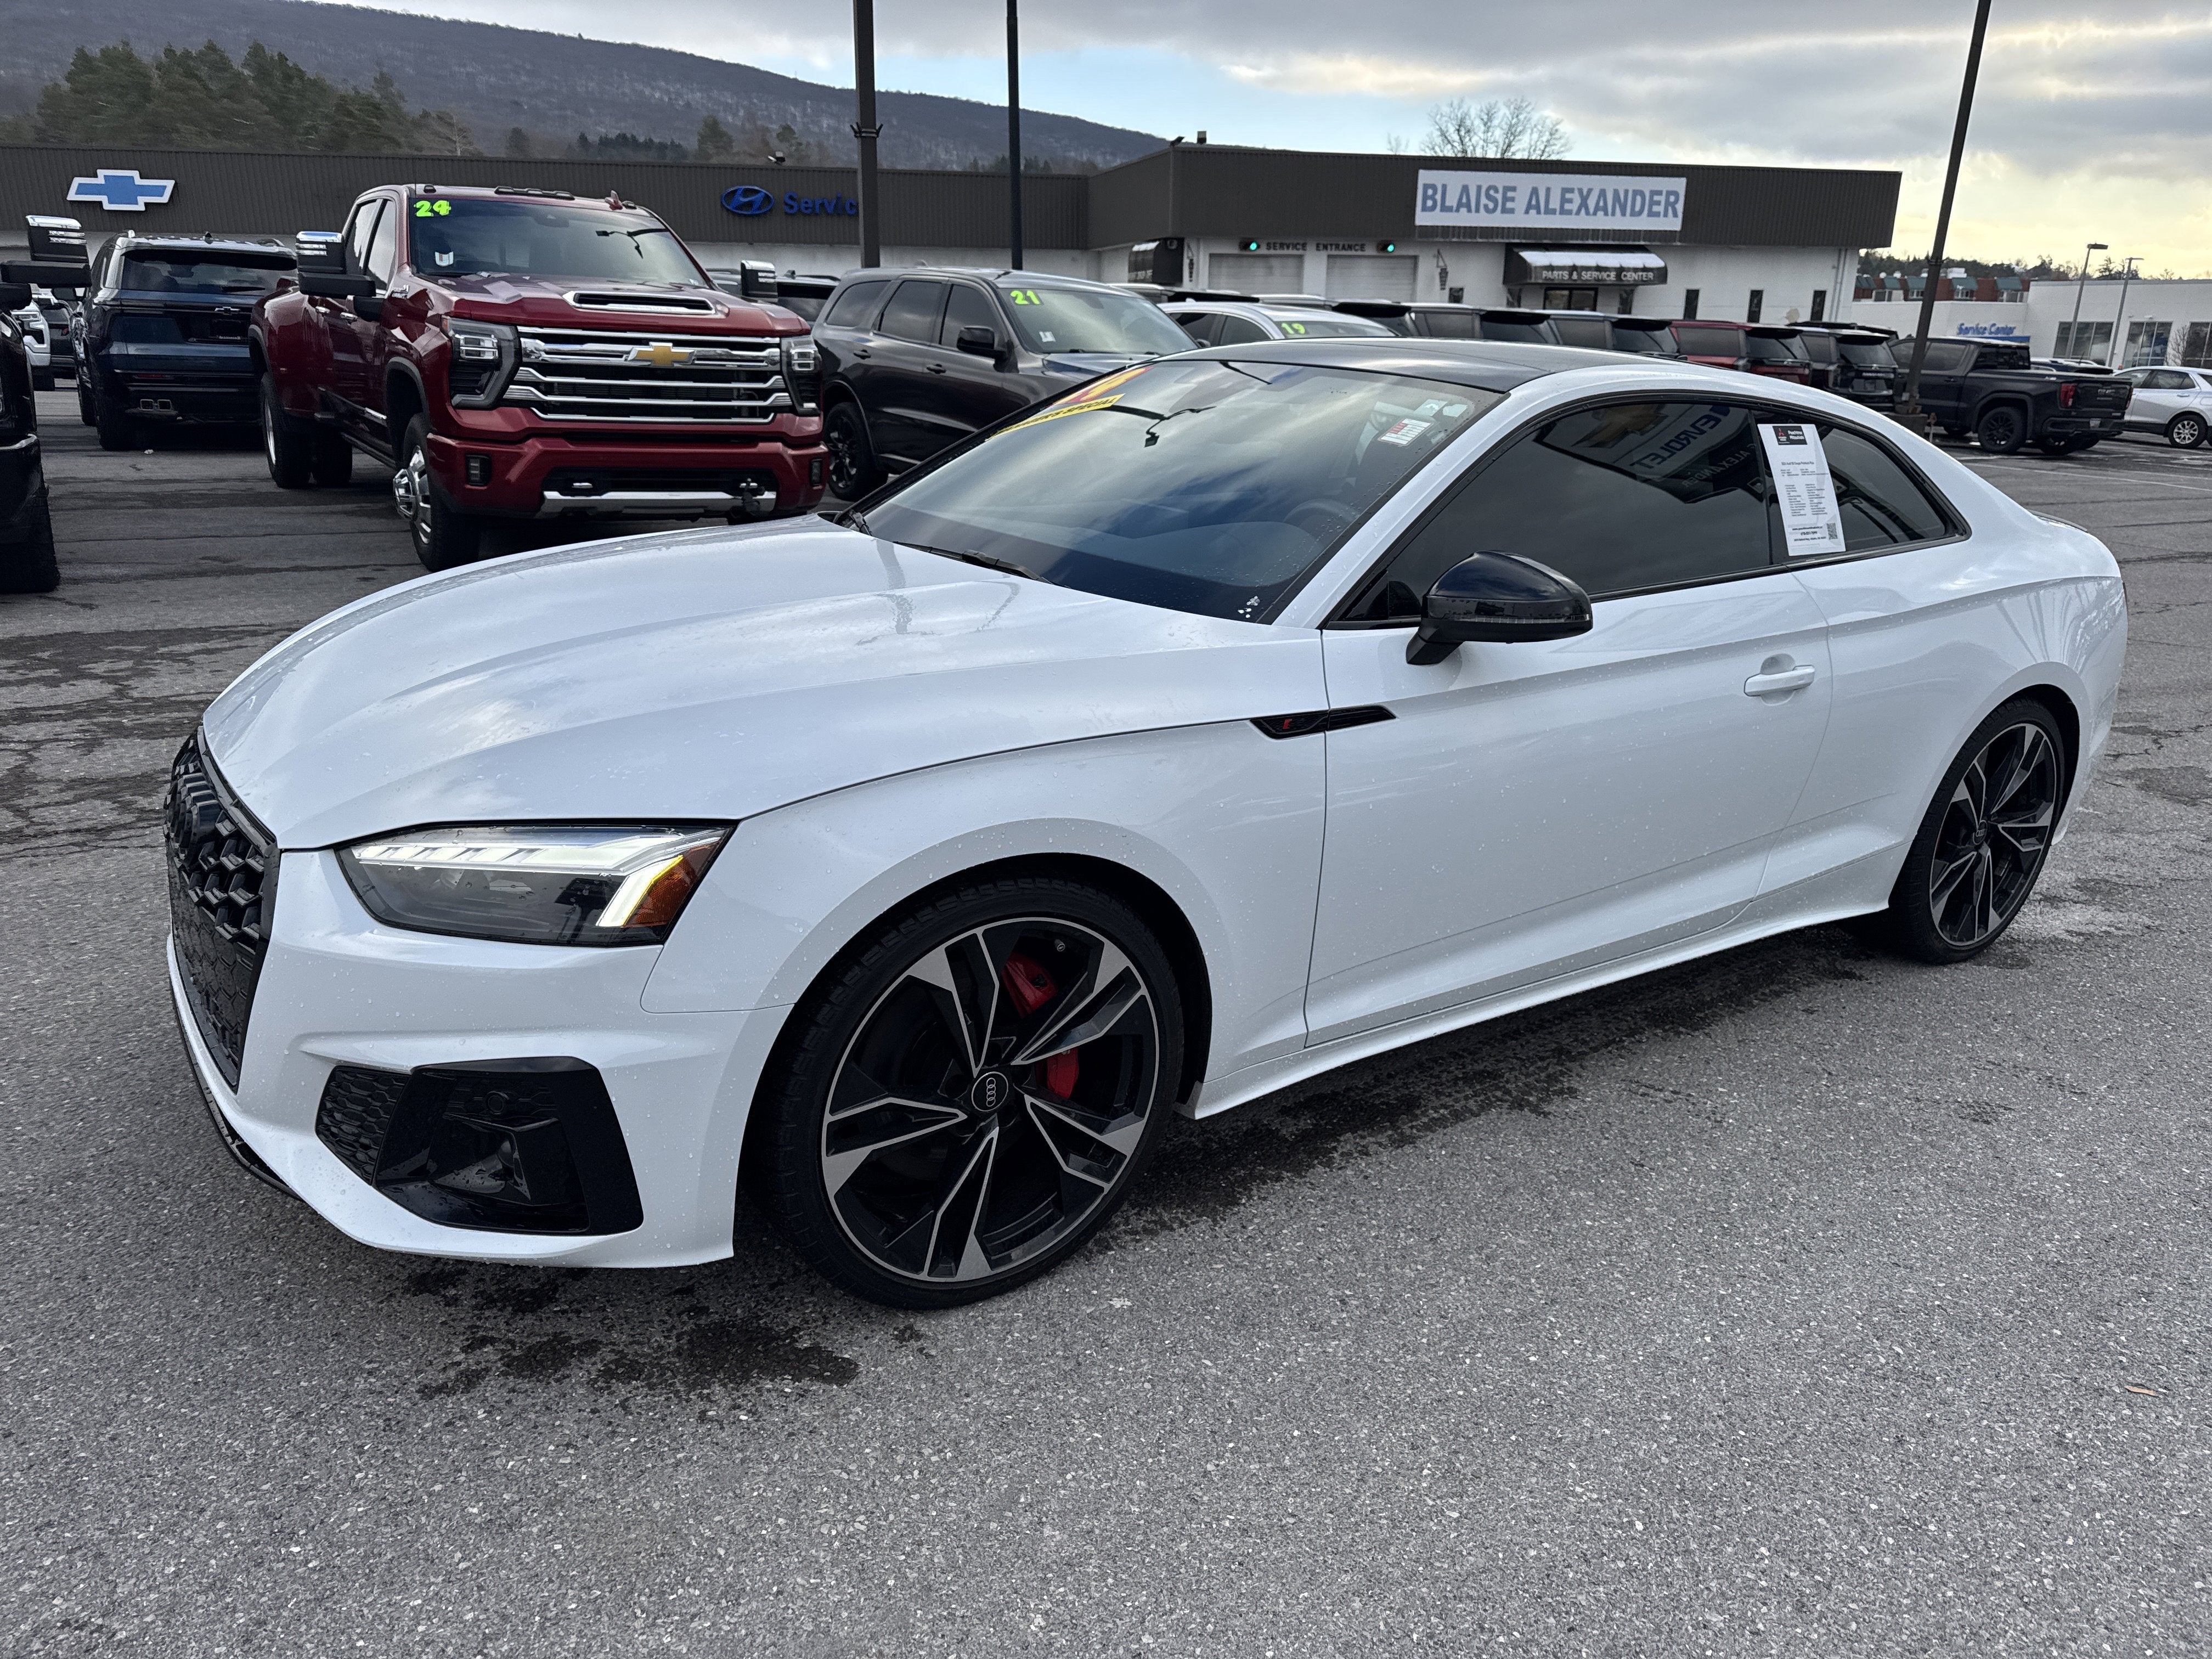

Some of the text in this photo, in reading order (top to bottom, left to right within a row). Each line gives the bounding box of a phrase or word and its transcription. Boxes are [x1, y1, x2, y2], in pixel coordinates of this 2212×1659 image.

[783, 191, 857, 215] Servic
[1420, 183, 1681, 218] BLAISE ALEXANDER
[414, 200, 452, 217] 24
[1266, 242, 1366, 252] SERVICE ENTRANCE
[1542, 270, 1654, 281] PARTS & SERVICE CENTER
[1010, 290, 1040, 304] 21
[1281, 323, 1306, 335] 19
[1957, 323, 2016, 335] Service Center
